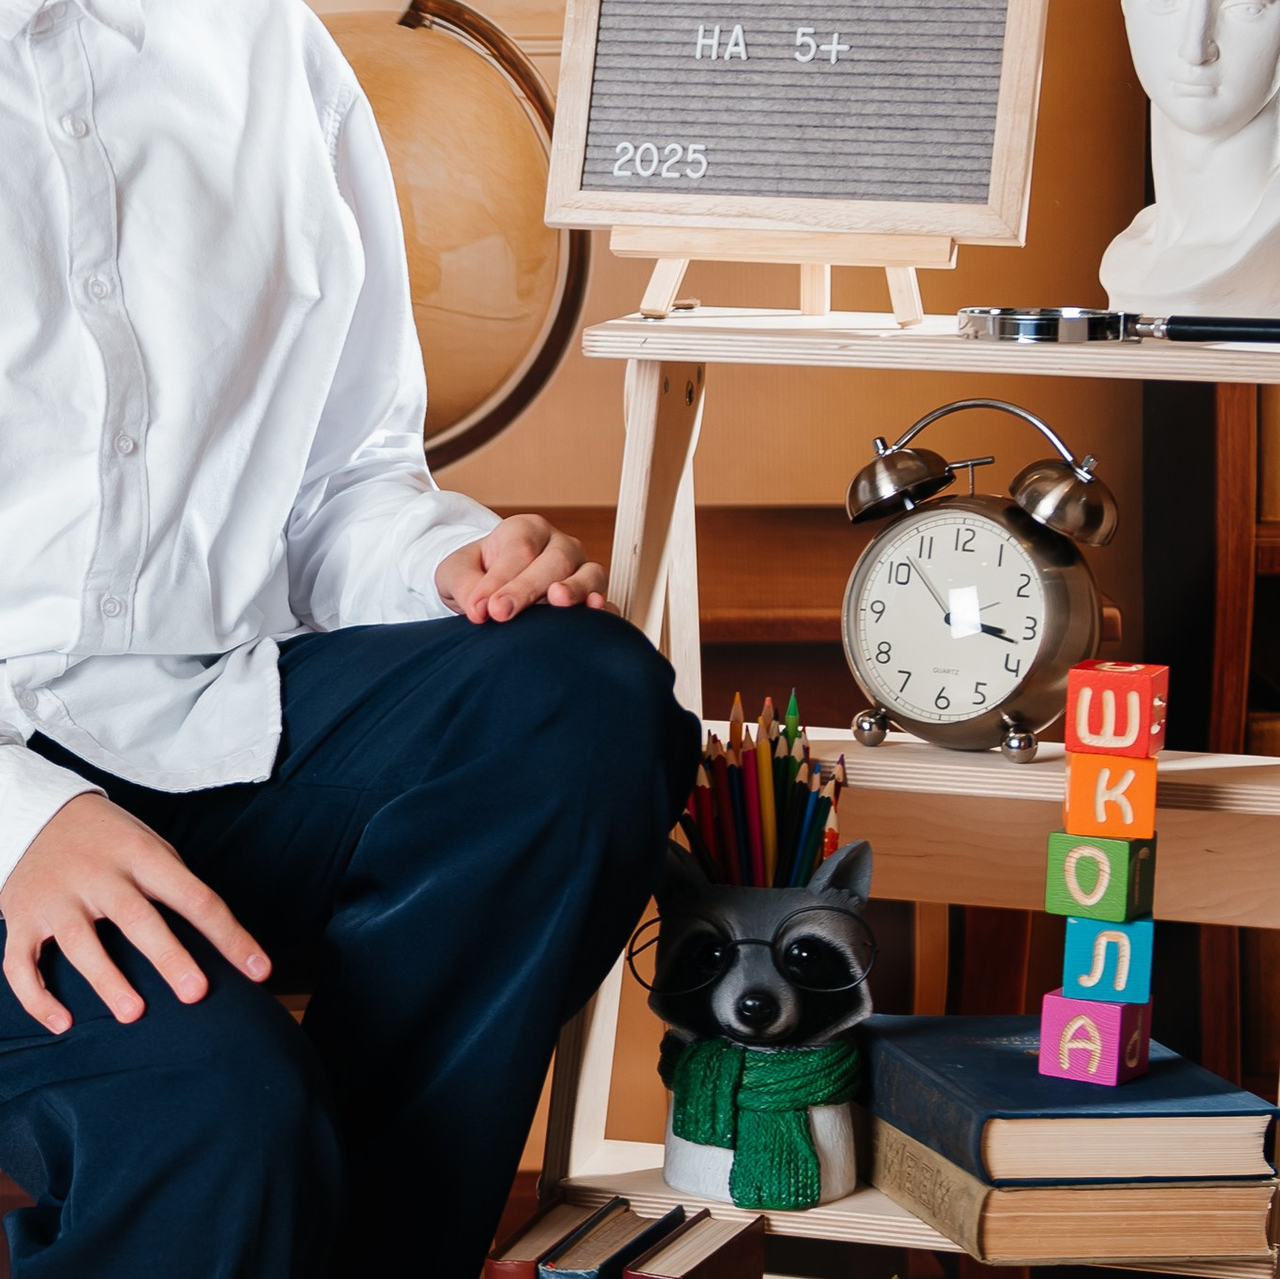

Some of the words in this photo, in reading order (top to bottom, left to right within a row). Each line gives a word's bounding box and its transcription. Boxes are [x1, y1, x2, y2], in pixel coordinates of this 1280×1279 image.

[693, 23, 750, 62] НА
[793, 27, 852, 65] 5+
[612, 141, 710, 180] 2025
[918, 535, 934, 560] 11
[954, 527, 976, 553] 12
[997, 543, 1005, 568] 1
[887, 560, 911, 586] 10
[1016, 573, 1032, 599] 2
[870, 599, 886, 624] 9
[1022, 615, 1038, 641] 3
[875, 640, 892, 665] 8
[1003, 652, 1021, 678] 4
[896, 669, 912, 694] 7
[932, 666, 961, 676] QUARTZ
[934, 686, 951, 711] 6
[972, 681, 988, 707] 5
